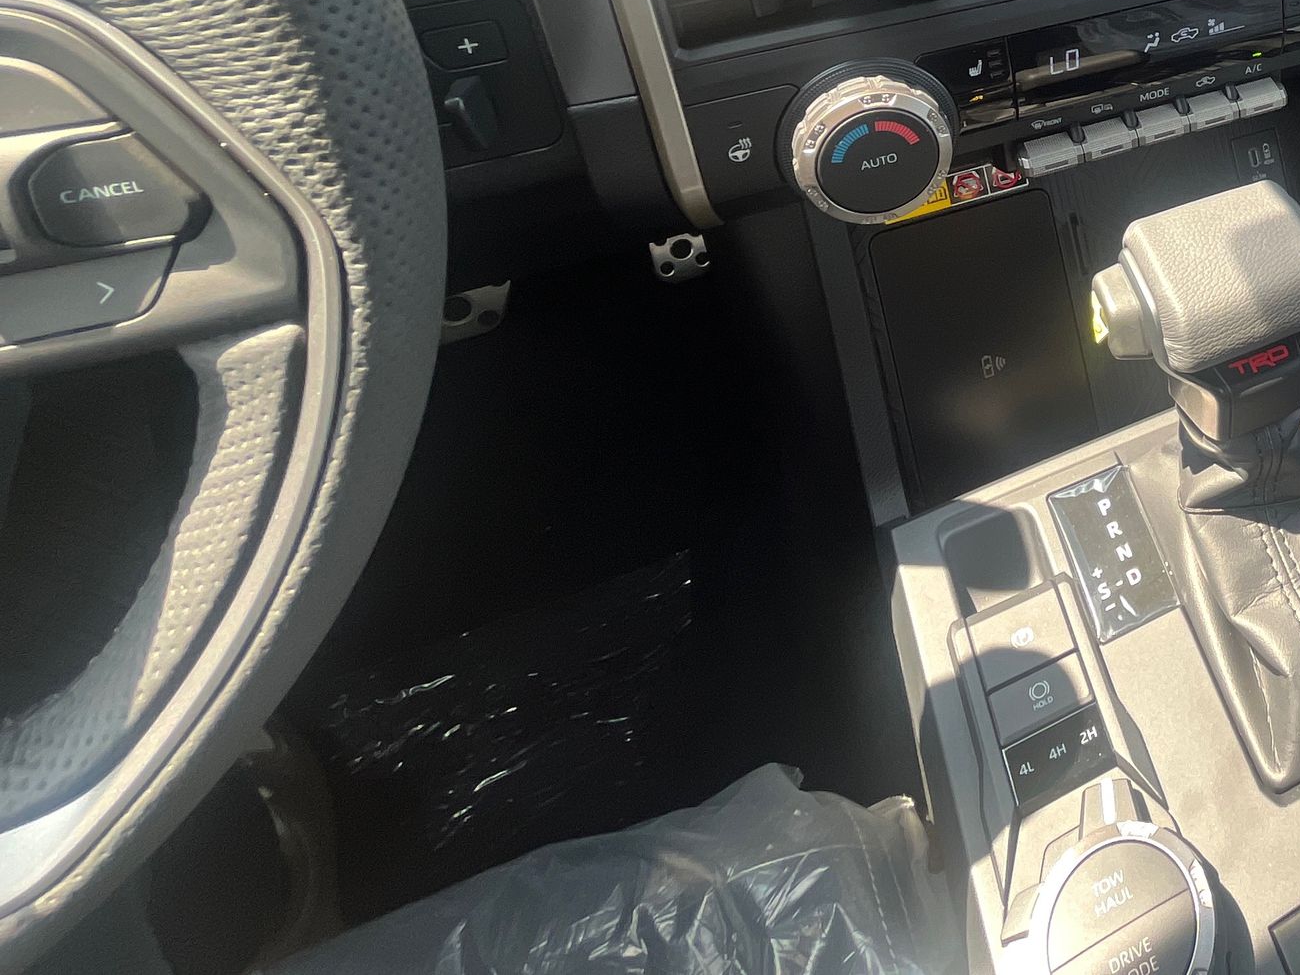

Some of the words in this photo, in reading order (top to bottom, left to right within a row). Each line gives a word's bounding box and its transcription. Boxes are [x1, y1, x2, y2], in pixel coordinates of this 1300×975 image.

[1050, 48, 1080, 75] LO
[1244, 62, 1263, 75] A/C
[1139, 86, 1170, 102] MODE
[860, 153, 898, 171] AUTO
[60, 181, 145, 204] CANCEL
[1227, 344, 1290, 375] TRD
[1097, 497, 1112, 516] P
[1106, 520, 1123, 539] R
[1115, 542, 1133, 562] N
[1097, 581, 1112, 601] S
[1126, 568, 1142, 586] D
[1032, 695, 1054, 711] HOLD
[1019, 761, 1035, 776] 4L
[1049, 743, 1067, 760] 4H
[1079, 725, 1098, 745] 2H
[1091, 869, 1125, 898] TOW
[1093, 887, 1134, 916] HAUL
[1108, 936, 1153, 974] DRIVE
